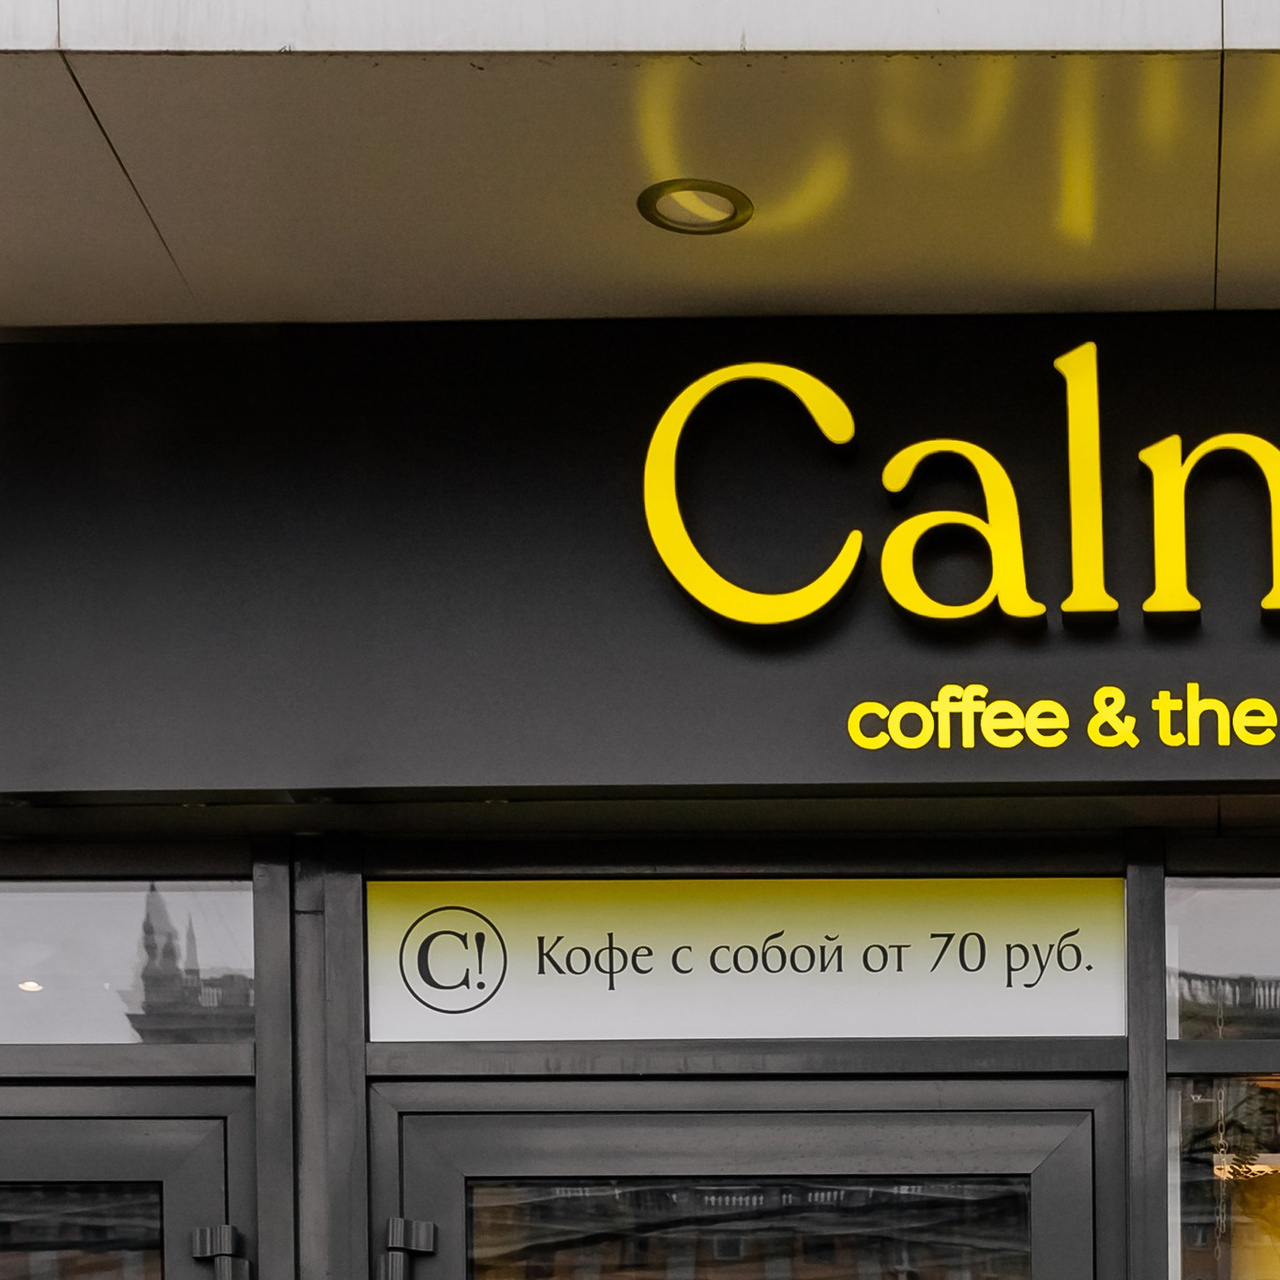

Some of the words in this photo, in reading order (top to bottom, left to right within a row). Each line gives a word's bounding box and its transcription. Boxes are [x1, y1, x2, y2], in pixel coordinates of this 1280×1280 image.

[847, 684, 1070, 749] coffee
[1086, 686, 1140, 748] &
[1152, 684, 1278, 746] the
[416, 930, 487, 990] C!
[536, 932, 656, 990] Кофе
[670, 943, 695, 974] с
[708, 929, 844, 974] собой
[861, 942, 913, 974] от
[929, 931, 987, 973] 70
[1005, 928, 1096, 988] руб.
